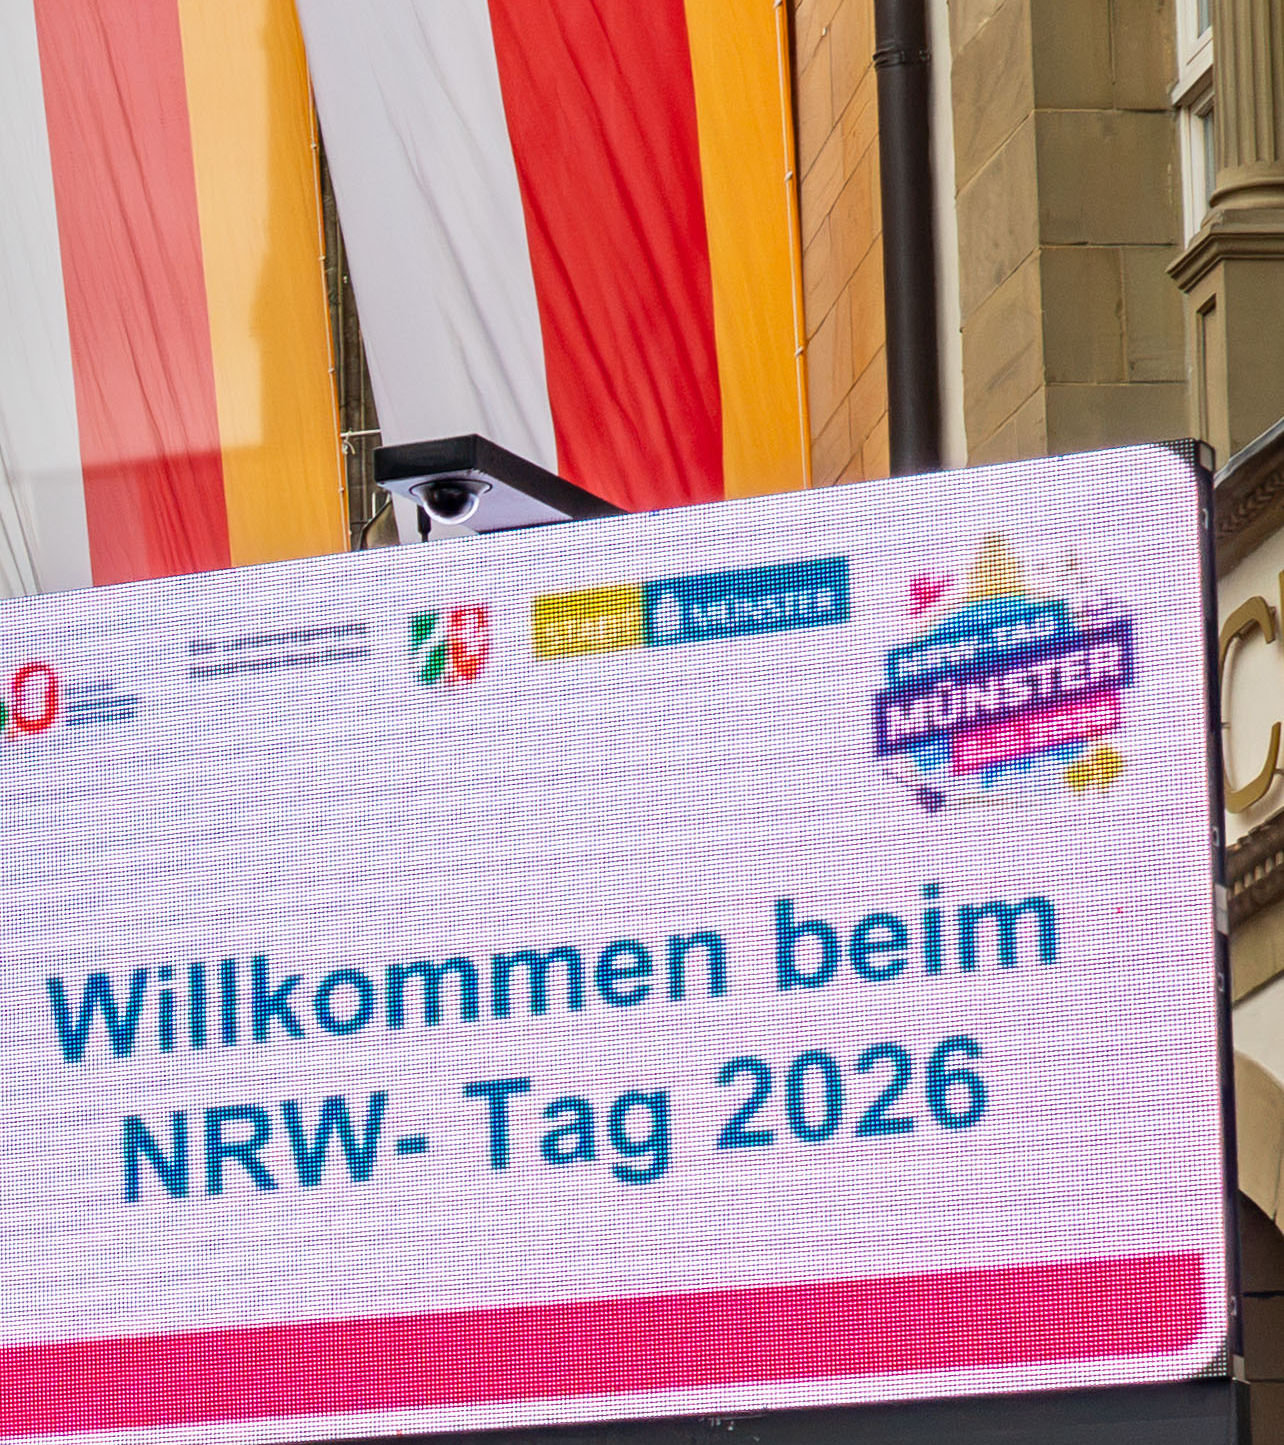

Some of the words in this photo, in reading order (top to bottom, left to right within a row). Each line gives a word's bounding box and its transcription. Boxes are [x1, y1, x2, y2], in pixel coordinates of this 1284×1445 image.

[545, 614, 636, 648] STADT
[692, 587, 834, 630] MÜNSTER
[897, 611, 1058, 679] NRW-TAG
[885, 641, 1123, 744] MÜNSTER
[1219, 570, 1284, 813] C
[47, 928, 727, 1063] Willkommen
[773, 882, 1062, 993] beim
[122, 1089, 430, 1203] NRW-
[463, 1076, 674, 1185] Tag
[715, 1035, 989, 1150] 2026
